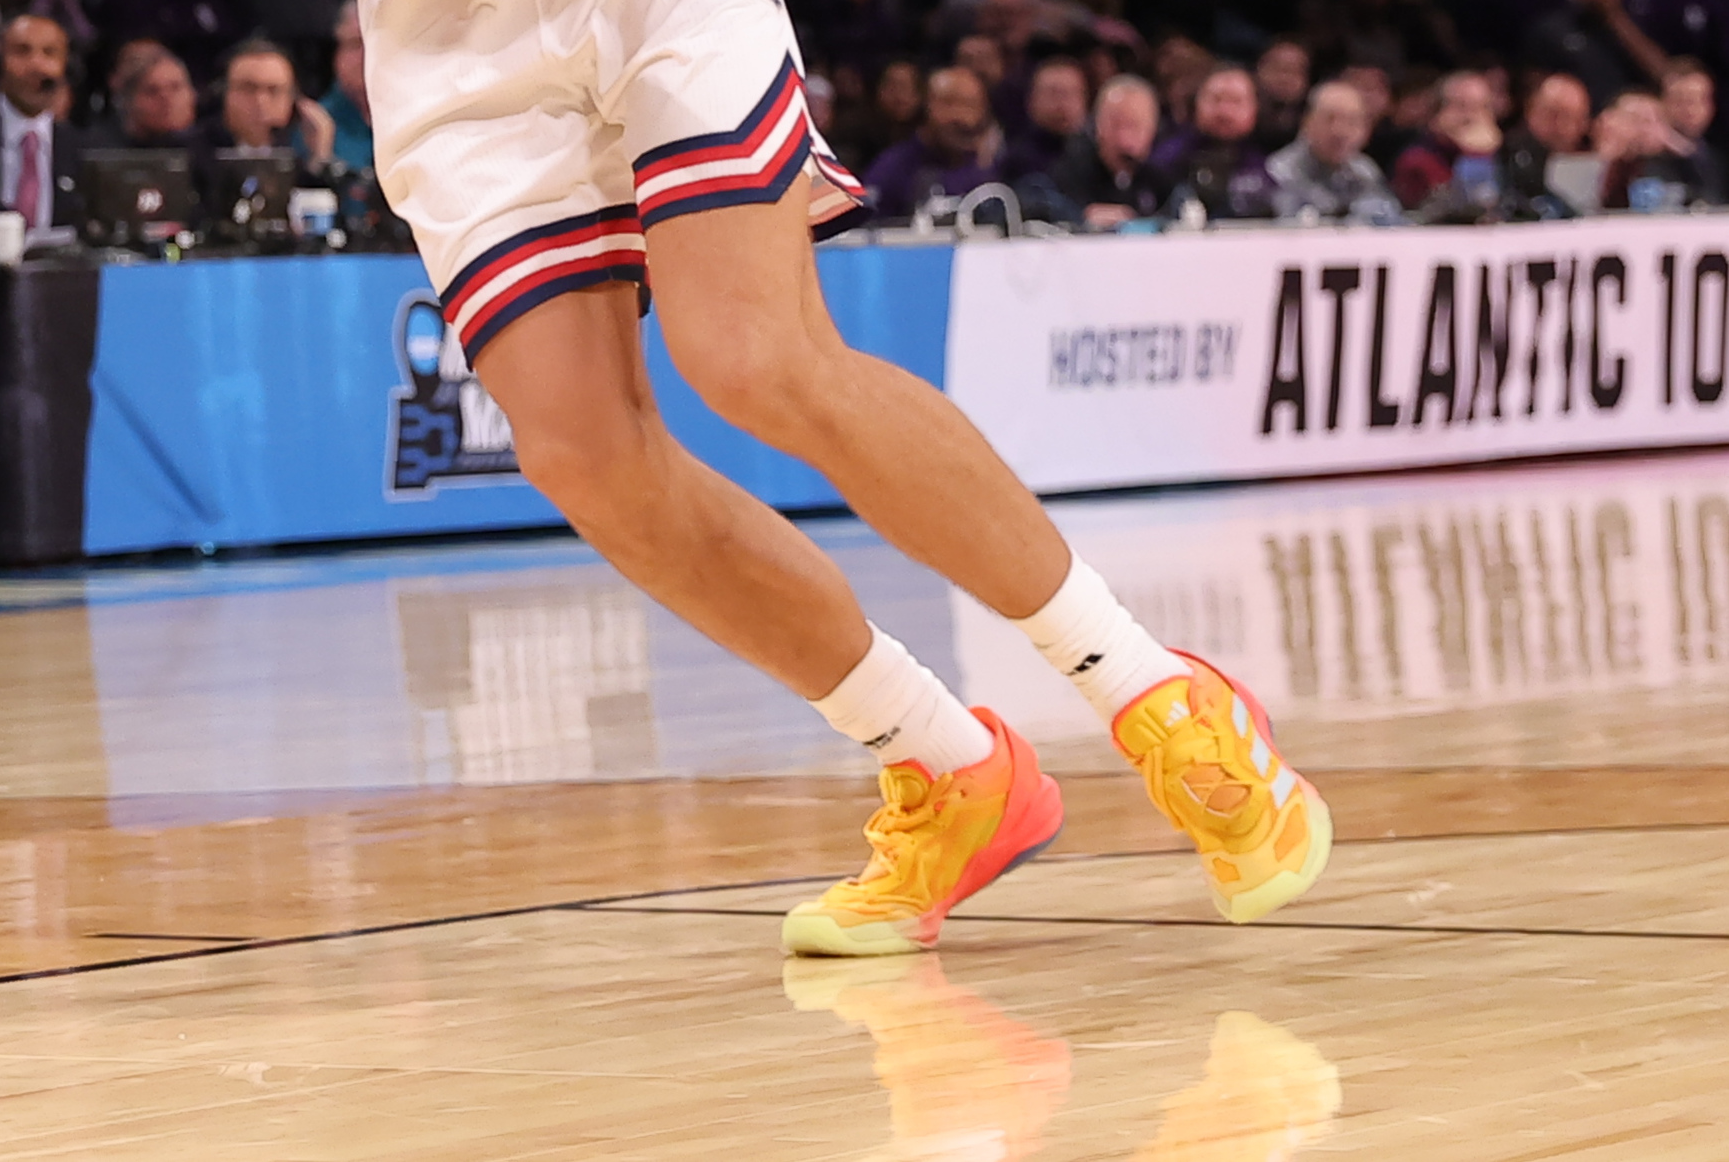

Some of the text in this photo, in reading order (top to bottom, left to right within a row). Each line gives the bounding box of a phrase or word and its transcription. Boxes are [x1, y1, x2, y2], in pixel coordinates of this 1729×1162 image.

[1049, 252, 1729, 435] HOSTED BY ATLANTIC 10
